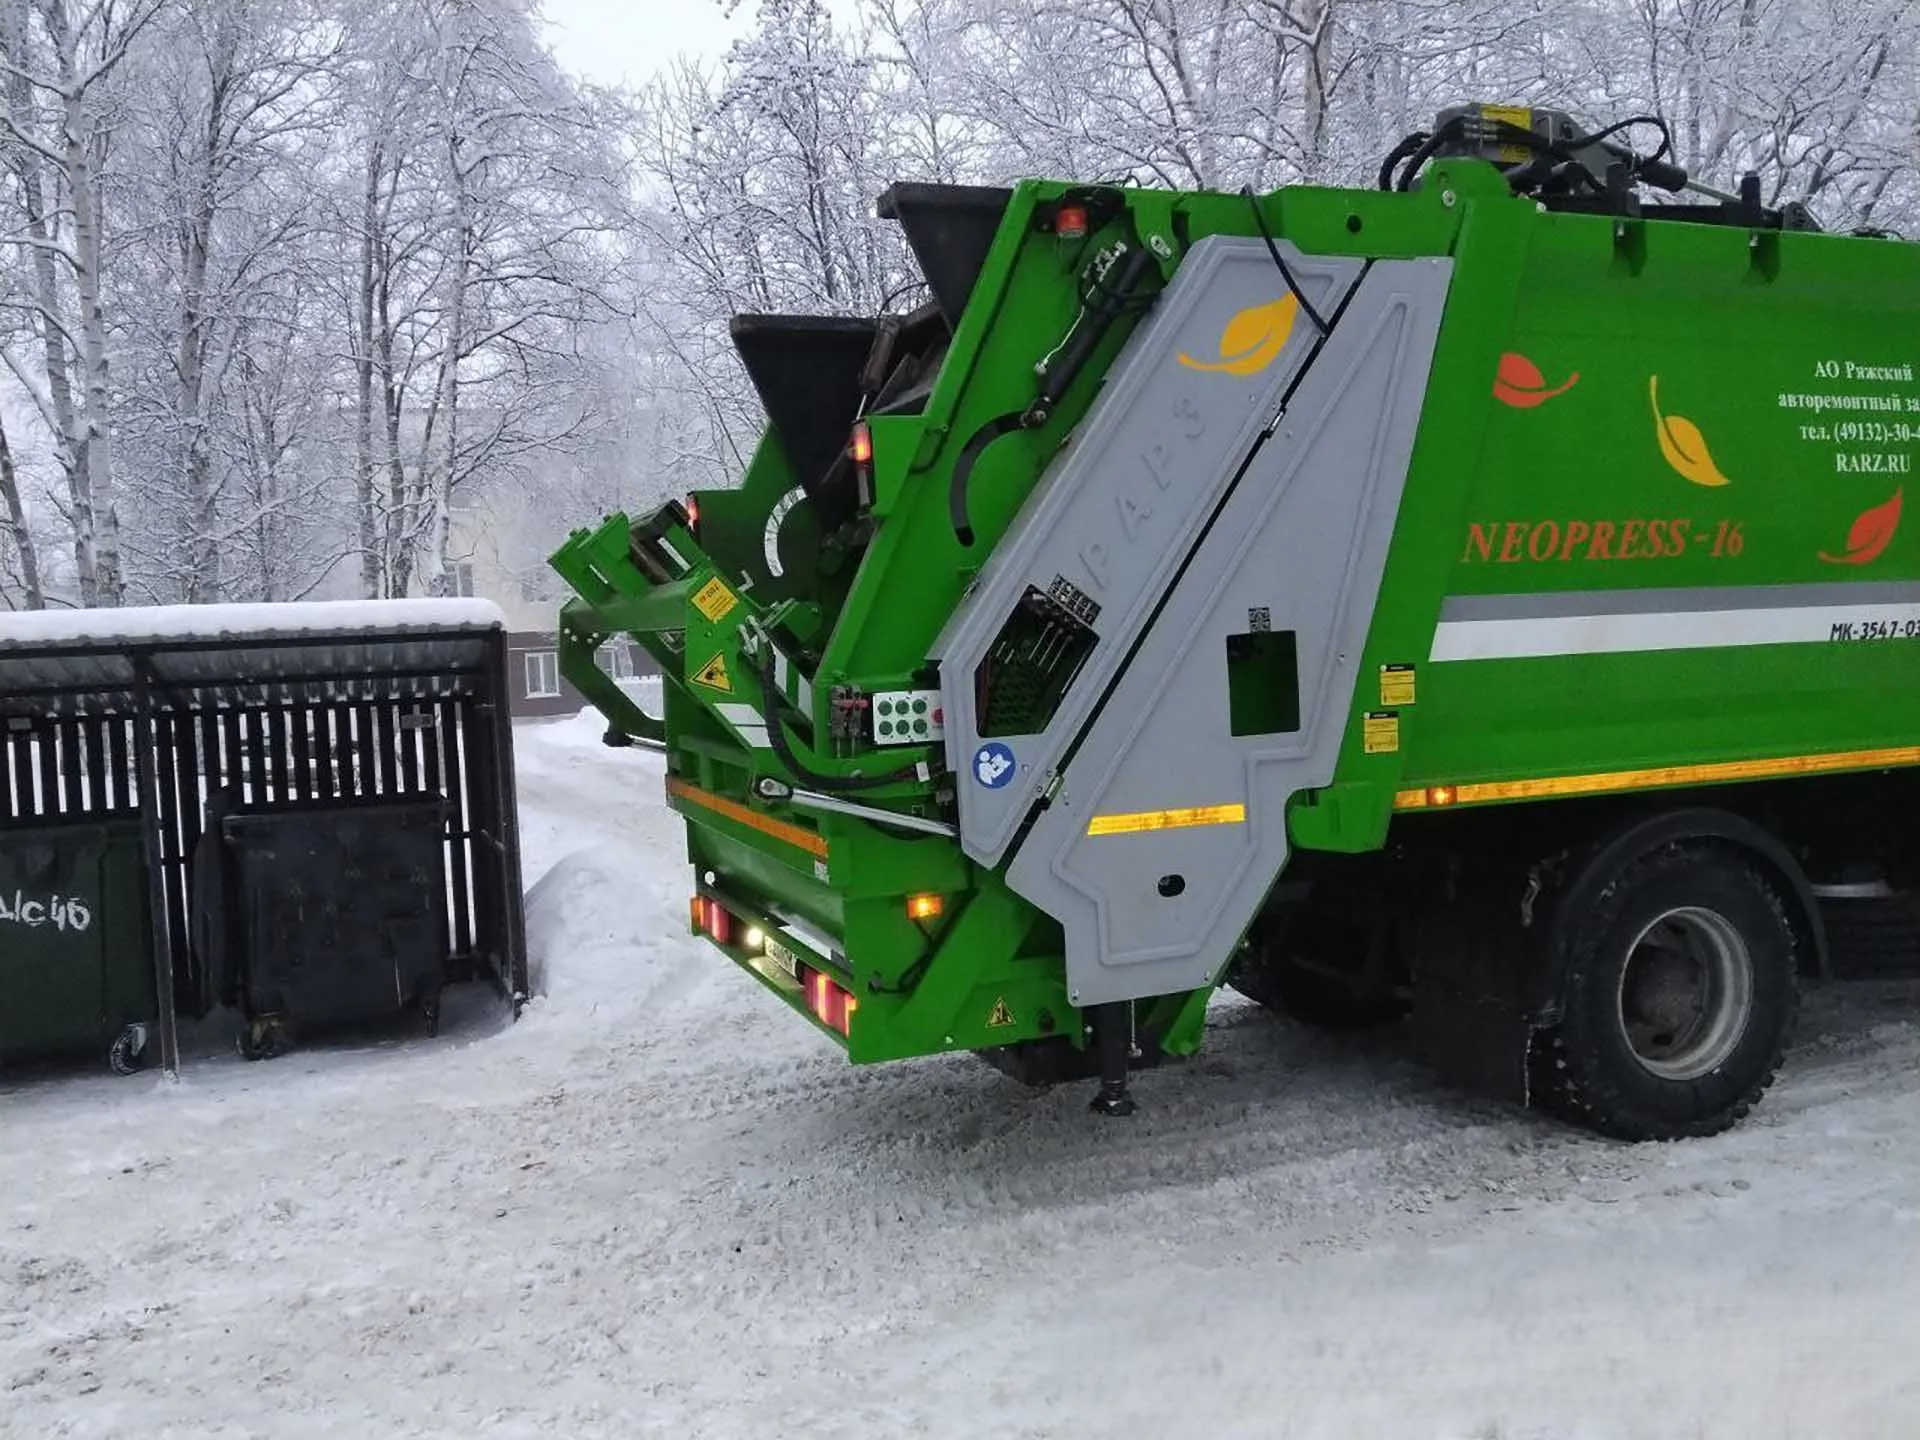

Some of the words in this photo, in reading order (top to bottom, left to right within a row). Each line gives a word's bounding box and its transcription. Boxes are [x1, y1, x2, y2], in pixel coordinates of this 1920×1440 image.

[1814, 360, 1839, 378] АО
[1845, 360, 1913, 381] Ряжский
[1778, 392, 1902, 414] авторемонтный
[1800, 425, 1831, 440] тел.
[1836, 453, 1911, 473] RARZ.RU
